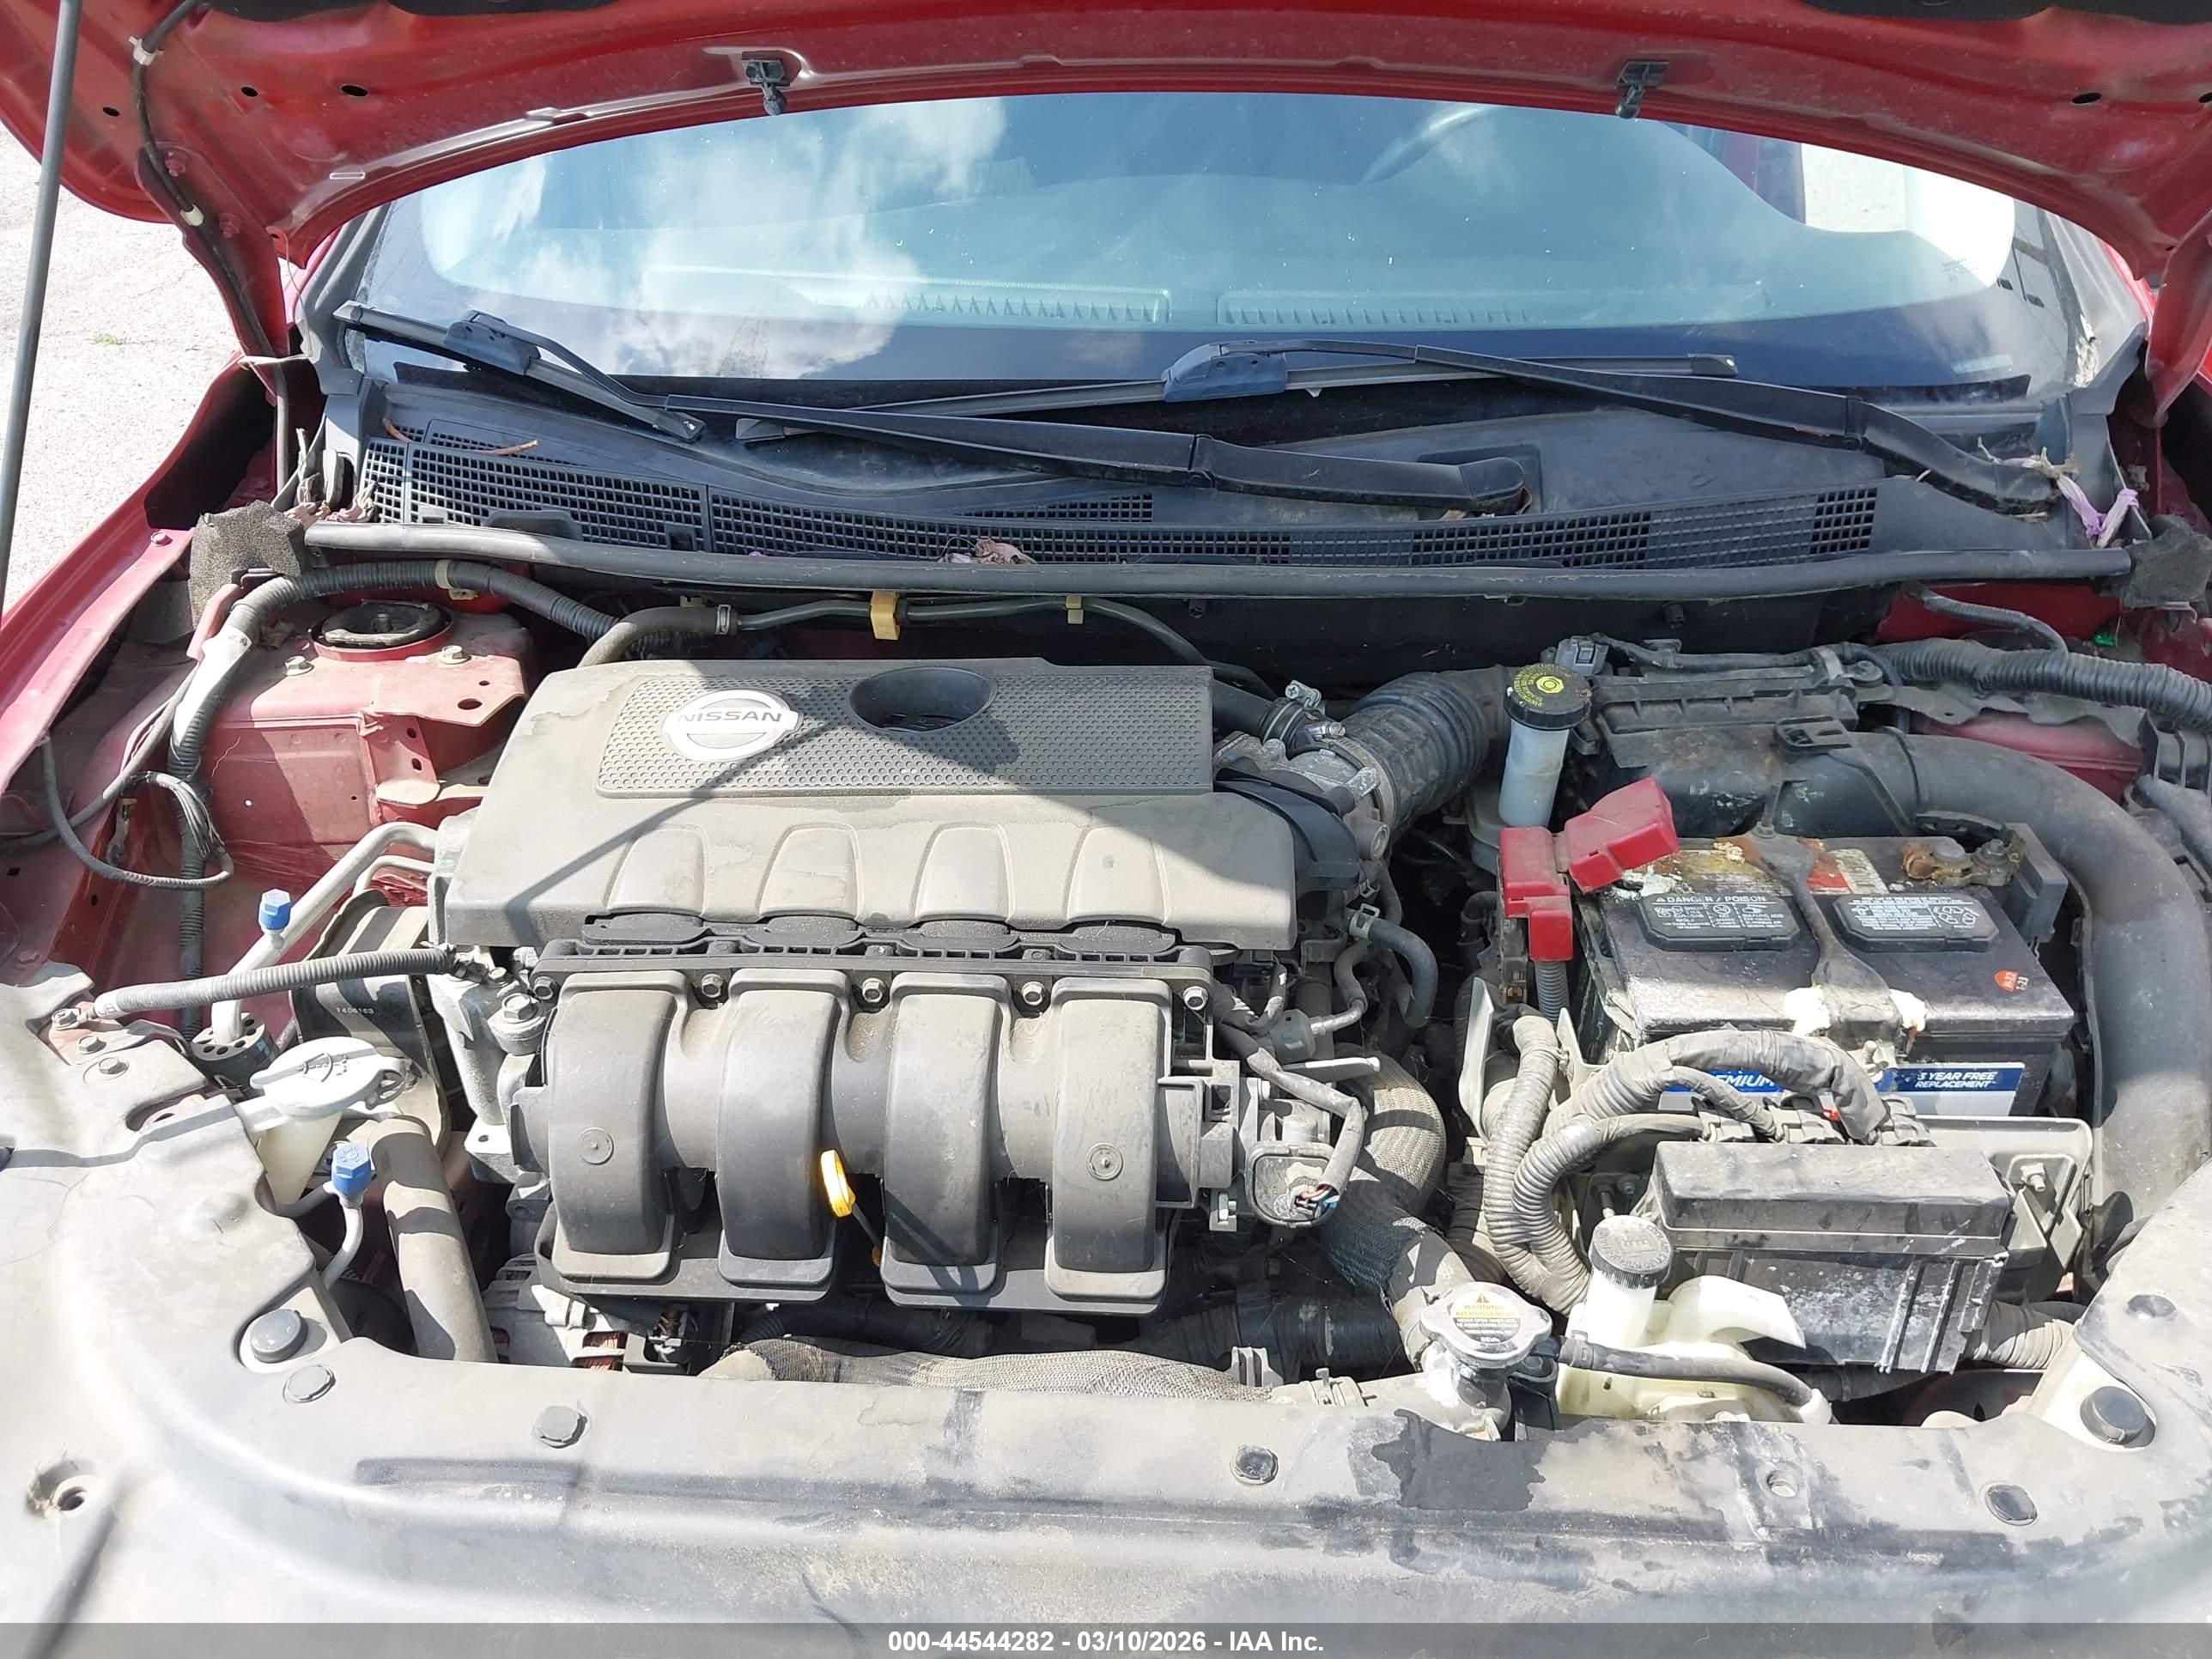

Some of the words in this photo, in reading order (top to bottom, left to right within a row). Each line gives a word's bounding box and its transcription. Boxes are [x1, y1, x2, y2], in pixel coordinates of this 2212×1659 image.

[678, 711, 782, 722] NISSAN
[1666, 895, 1714, 903] DANGER
[1917, 1072, 1926, 1081] 3
[1929, 1072, 1963, 1081] YEAR
[1962, 1071, 1998, 1080] FREE
